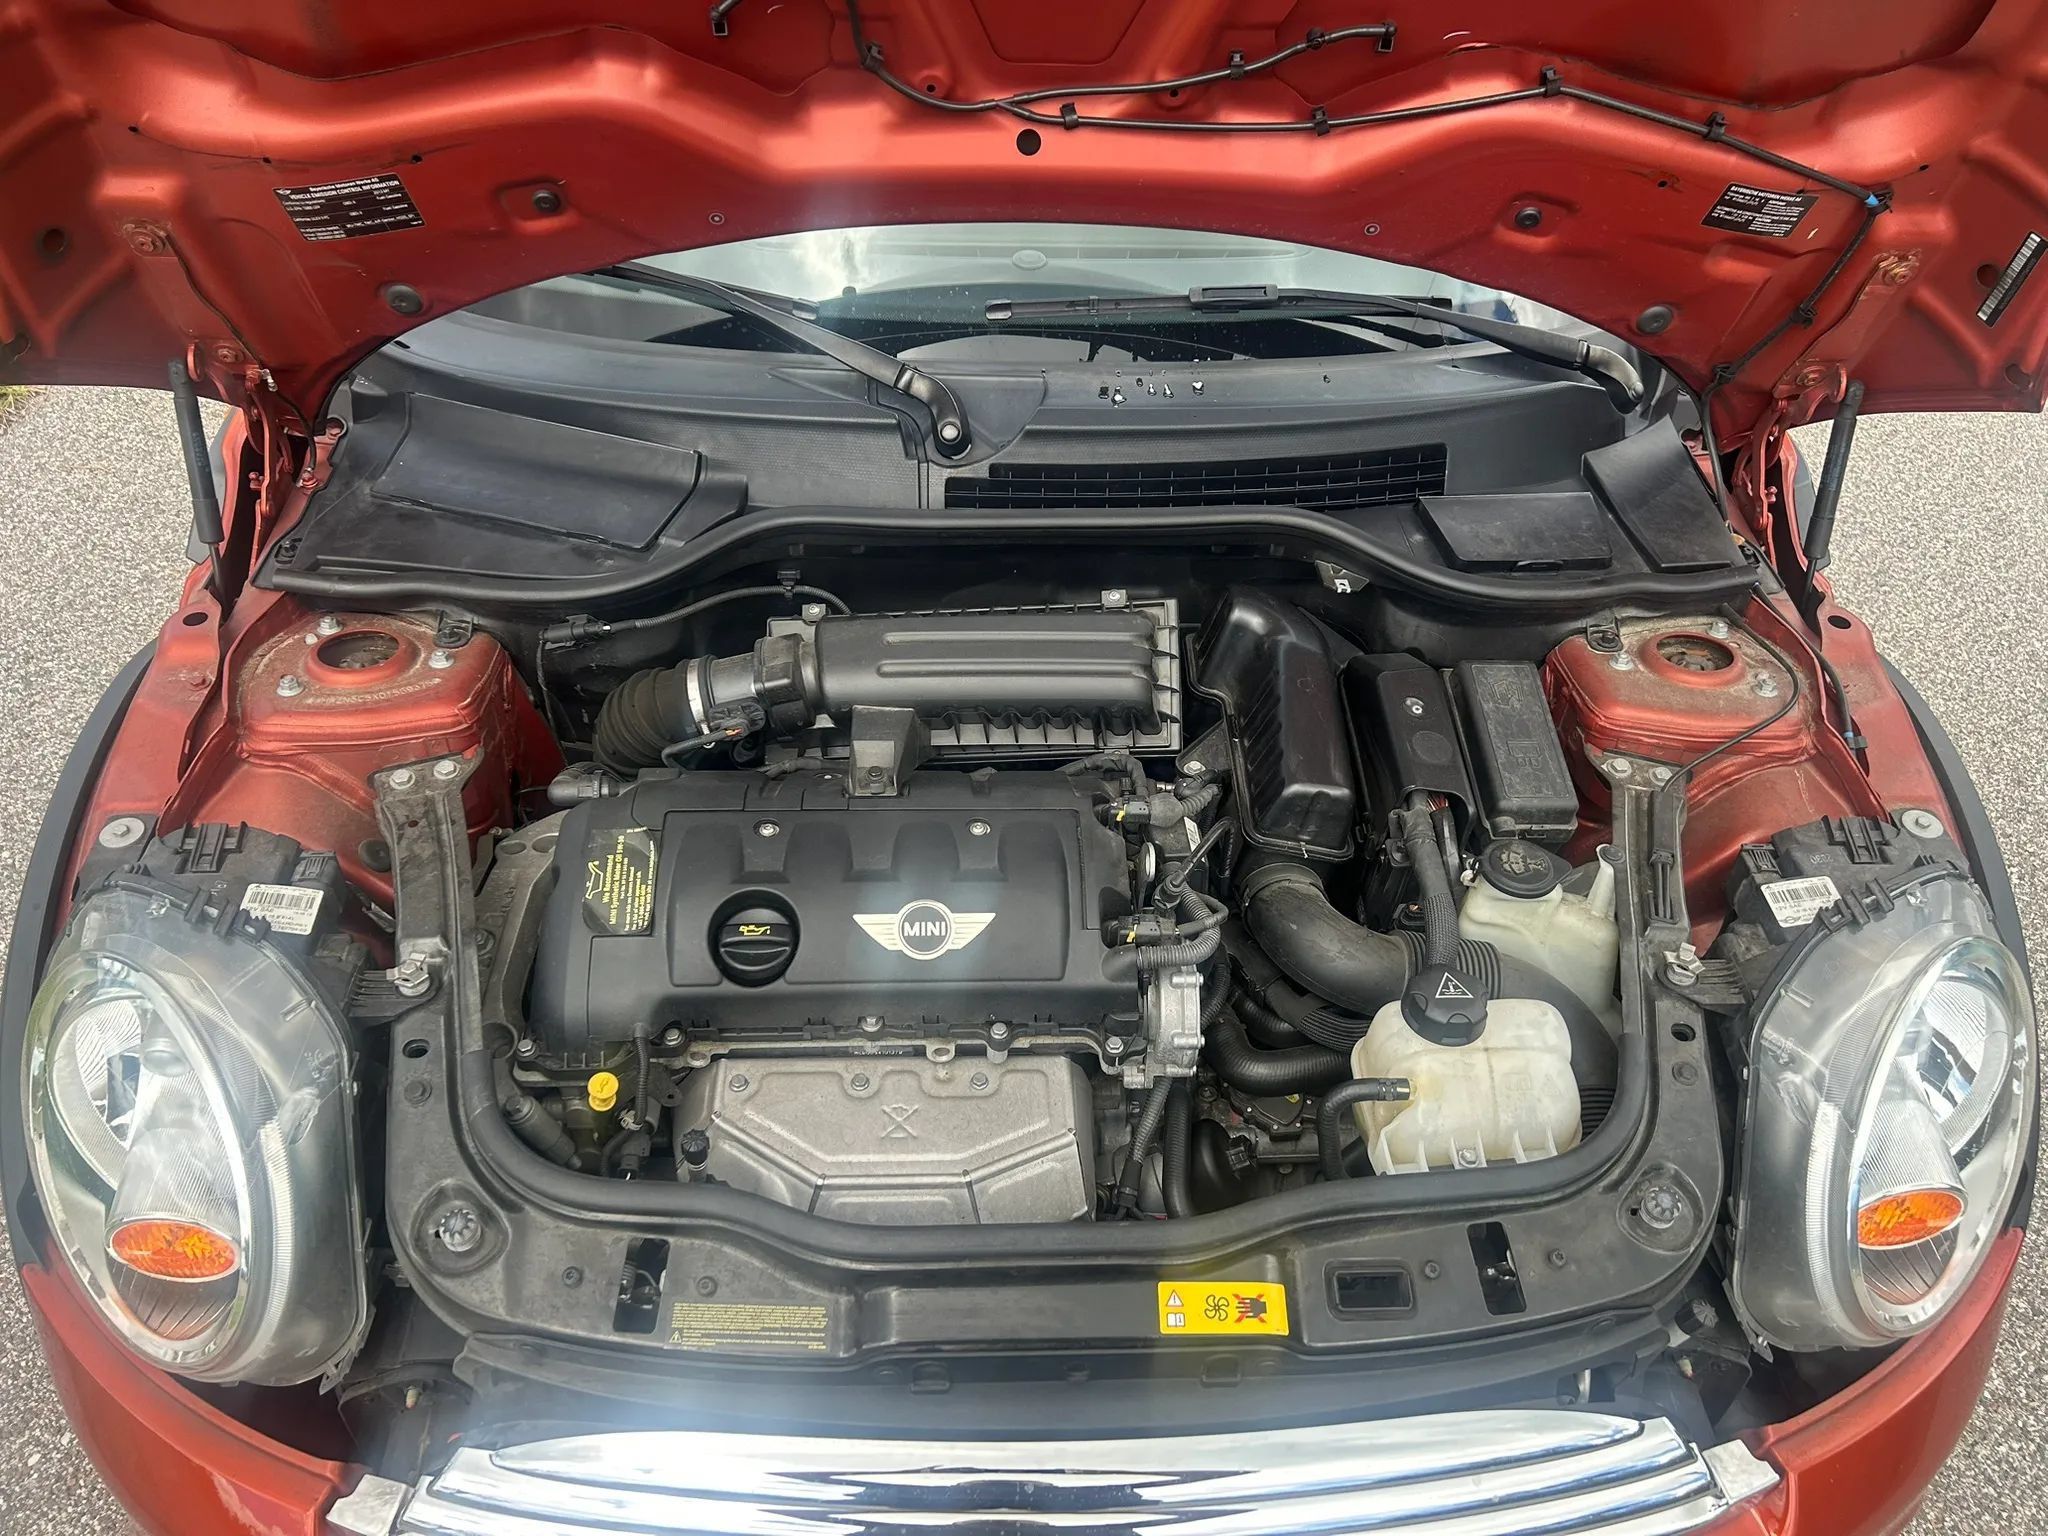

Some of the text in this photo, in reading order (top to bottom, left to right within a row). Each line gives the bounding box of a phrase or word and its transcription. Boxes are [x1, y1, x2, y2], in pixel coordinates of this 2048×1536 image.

[310, 189, 338, 198] EMISSION
[337, 186, 363, 195] CONTROL
[361, 180, 400, 190] INFORMATION
[601, 855, 614, 904] We Recommend
[613, 863, 621, 880] Motor
[611, 881, 619, 908] Synthetic
[903, 921, 946, 937] MINI
